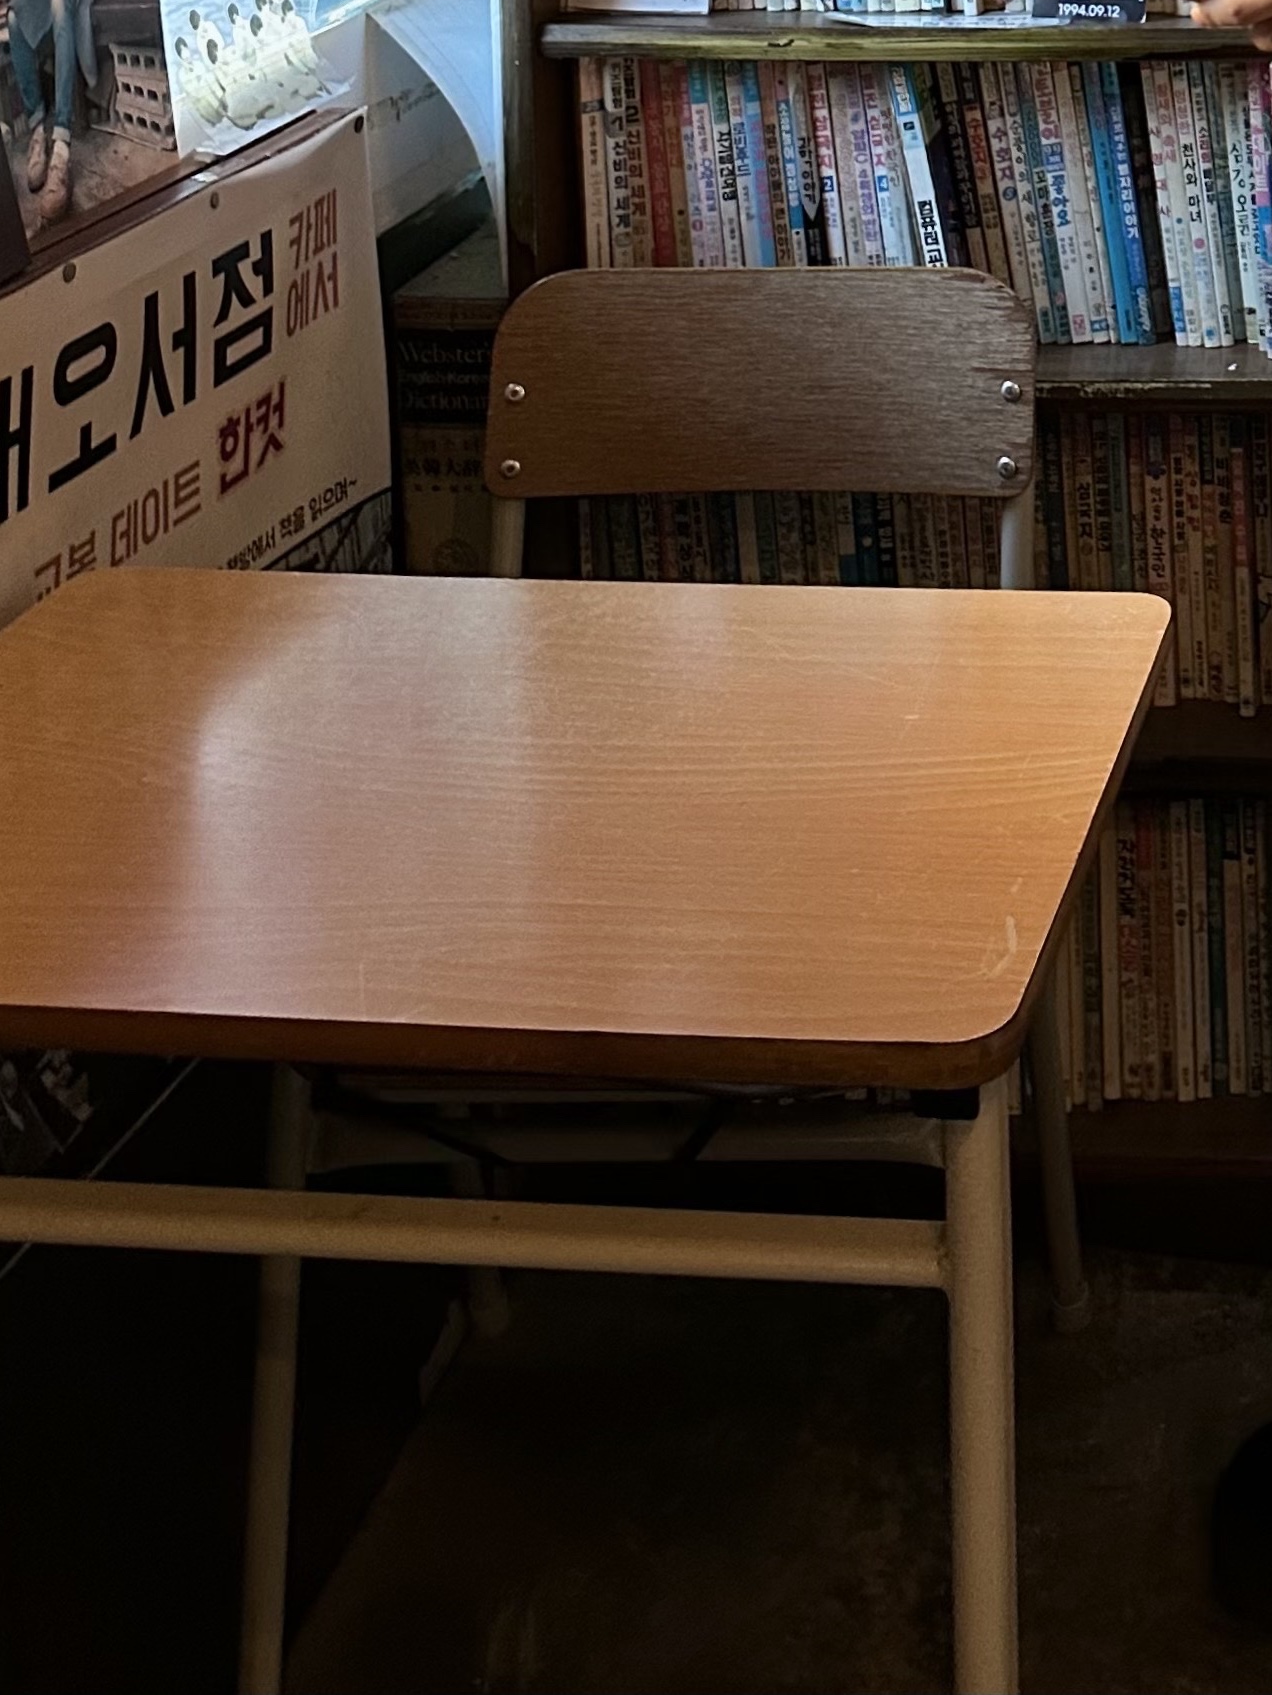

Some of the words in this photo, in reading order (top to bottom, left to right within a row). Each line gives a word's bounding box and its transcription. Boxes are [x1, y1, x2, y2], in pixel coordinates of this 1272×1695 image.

[1057, 2, 1121, 20] 1994.09.12
[289, 188, 339, 271] 카페
[286, 252, 341, 338] 에서
